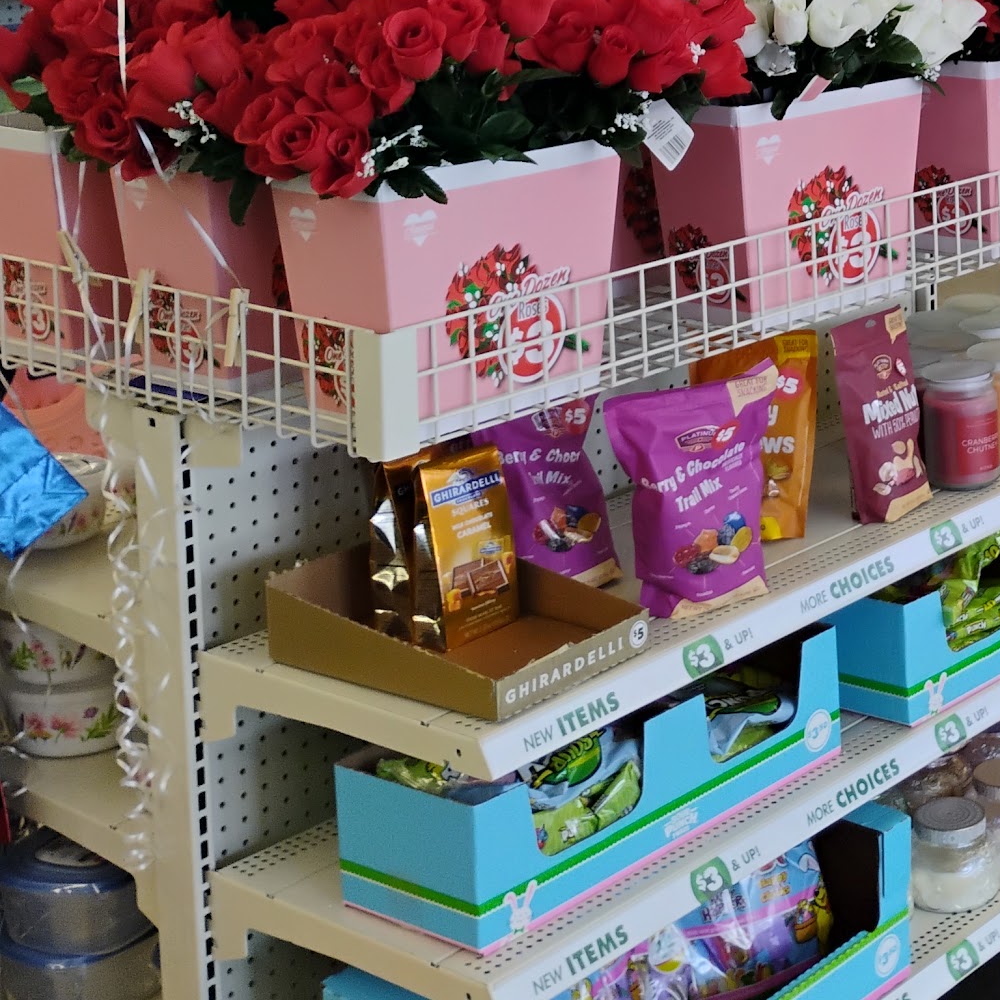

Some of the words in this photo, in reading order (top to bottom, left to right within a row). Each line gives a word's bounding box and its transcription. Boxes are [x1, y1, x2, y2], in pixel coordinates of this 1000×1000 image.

[522, 269, 568, 296] Dozen
[776, 374, 799, 394] $5
[565, 408, 587, 426] $5
[862, 390, 904, 425] Mixed
[715, 426, 737, 442] $5
[872, 420, 893, 439] WITH
[675, 465, 686, 483] &
[686, 441, 745, 477] Chocolate
[451, 498, 490, 517] SQUARES
[675, 486, 702, 513] Trail
[699, 476, 723, 498] Mix
[456, 521, 492, 539] CARAMEL
[523, 726, 553, 752] NEW
[556, 691, 620, 737] ITEMS
[687, 643, 717, 669] $3
[724, 638, 733, 650] &
[734, 627, 754, 646] UP!
[799, 590, 828, 614] MORE
[829, 556, 896, 600] CHOICES
[933, 525, 956, 548] $3
[961, 522, 969, 533] &
[970, 515, 984, 530] UP!
[505, 636, 624, 703] GHIRARDELLI
[633, 627, 645, 640] $5
[533, 966, 563, 995] NEW
[566, 925, 629, 976] ITEMS
[697, 863, 724, 892] $3
[731, 857, 741, 872] &
[742, 846, 761, 865] UP!
[806, 802, 835, 827] MORE
[835, 758, 900, 809] CHOICES
[939, 715, 960, 743] $3
[965, 716, 973, 728] &
[974, 707, 989, 723] UP!
[949, 946, 973, 973] $3
[977, 940, 984, 951] &
[985, 928, 1000, 945] UP!
